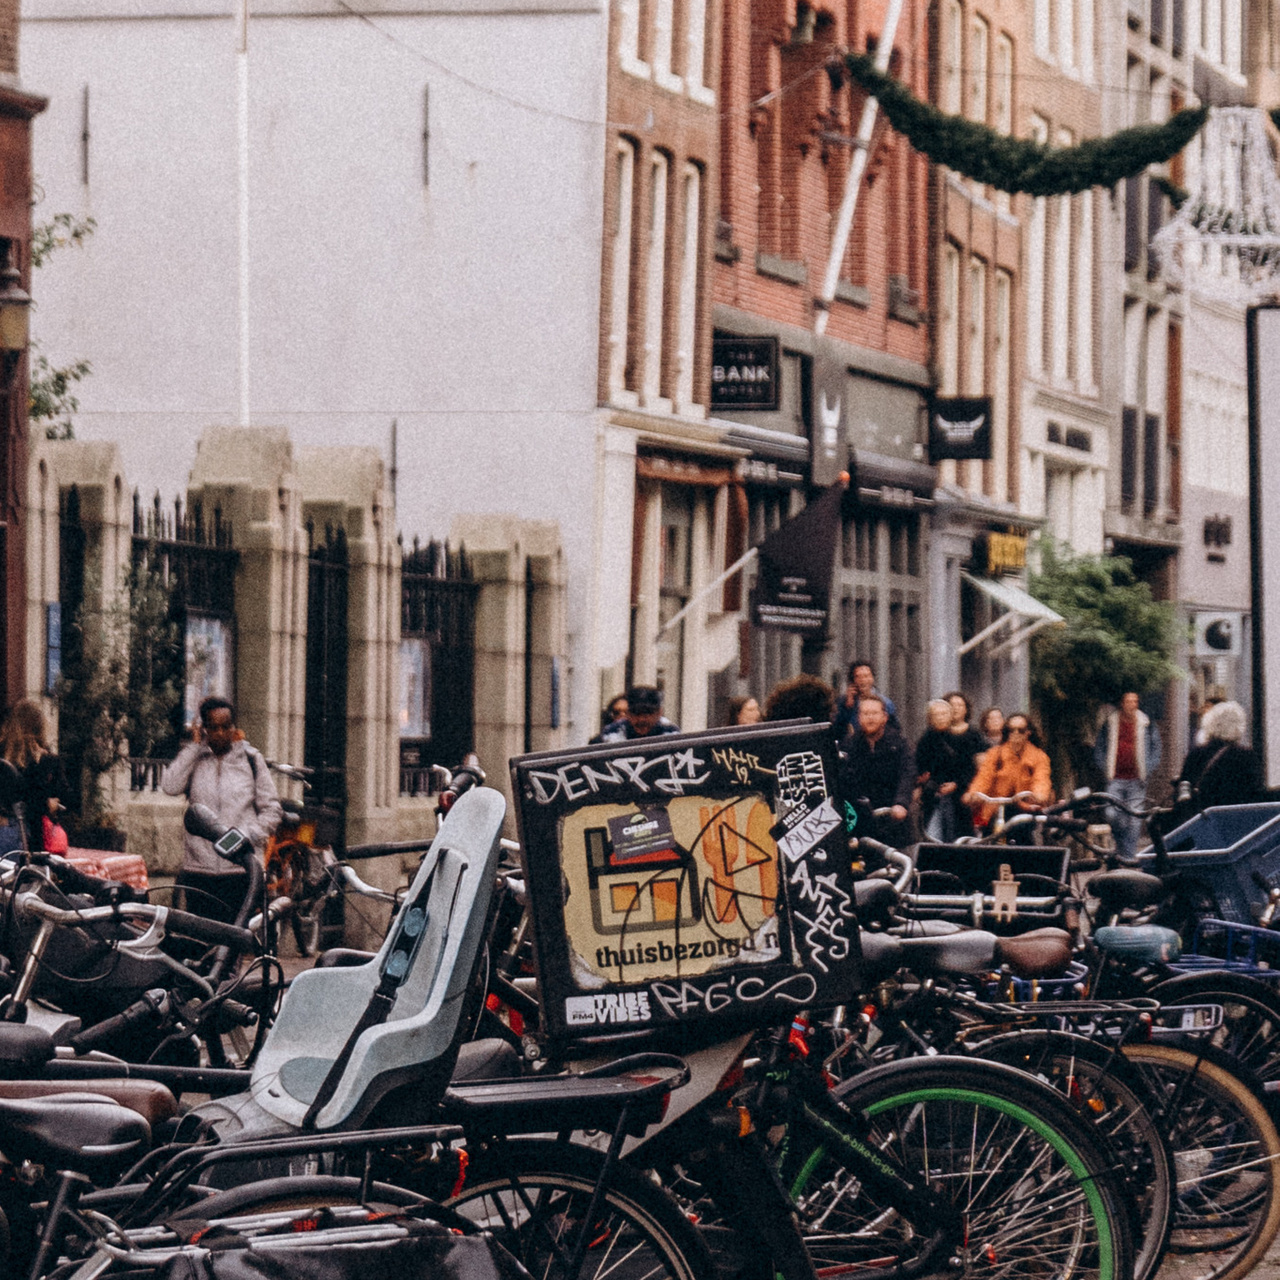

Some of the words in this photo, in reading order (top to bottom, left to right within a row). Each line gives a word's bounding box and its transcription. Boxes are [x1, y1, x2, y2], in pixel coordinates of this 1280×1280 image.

[713, 365, 771, 382] BANK
[781, 802, 808, 826] HELLO
[593, 991, 649, 1009] TRIBE
[595, 1005, 652, 1024] VIBES
